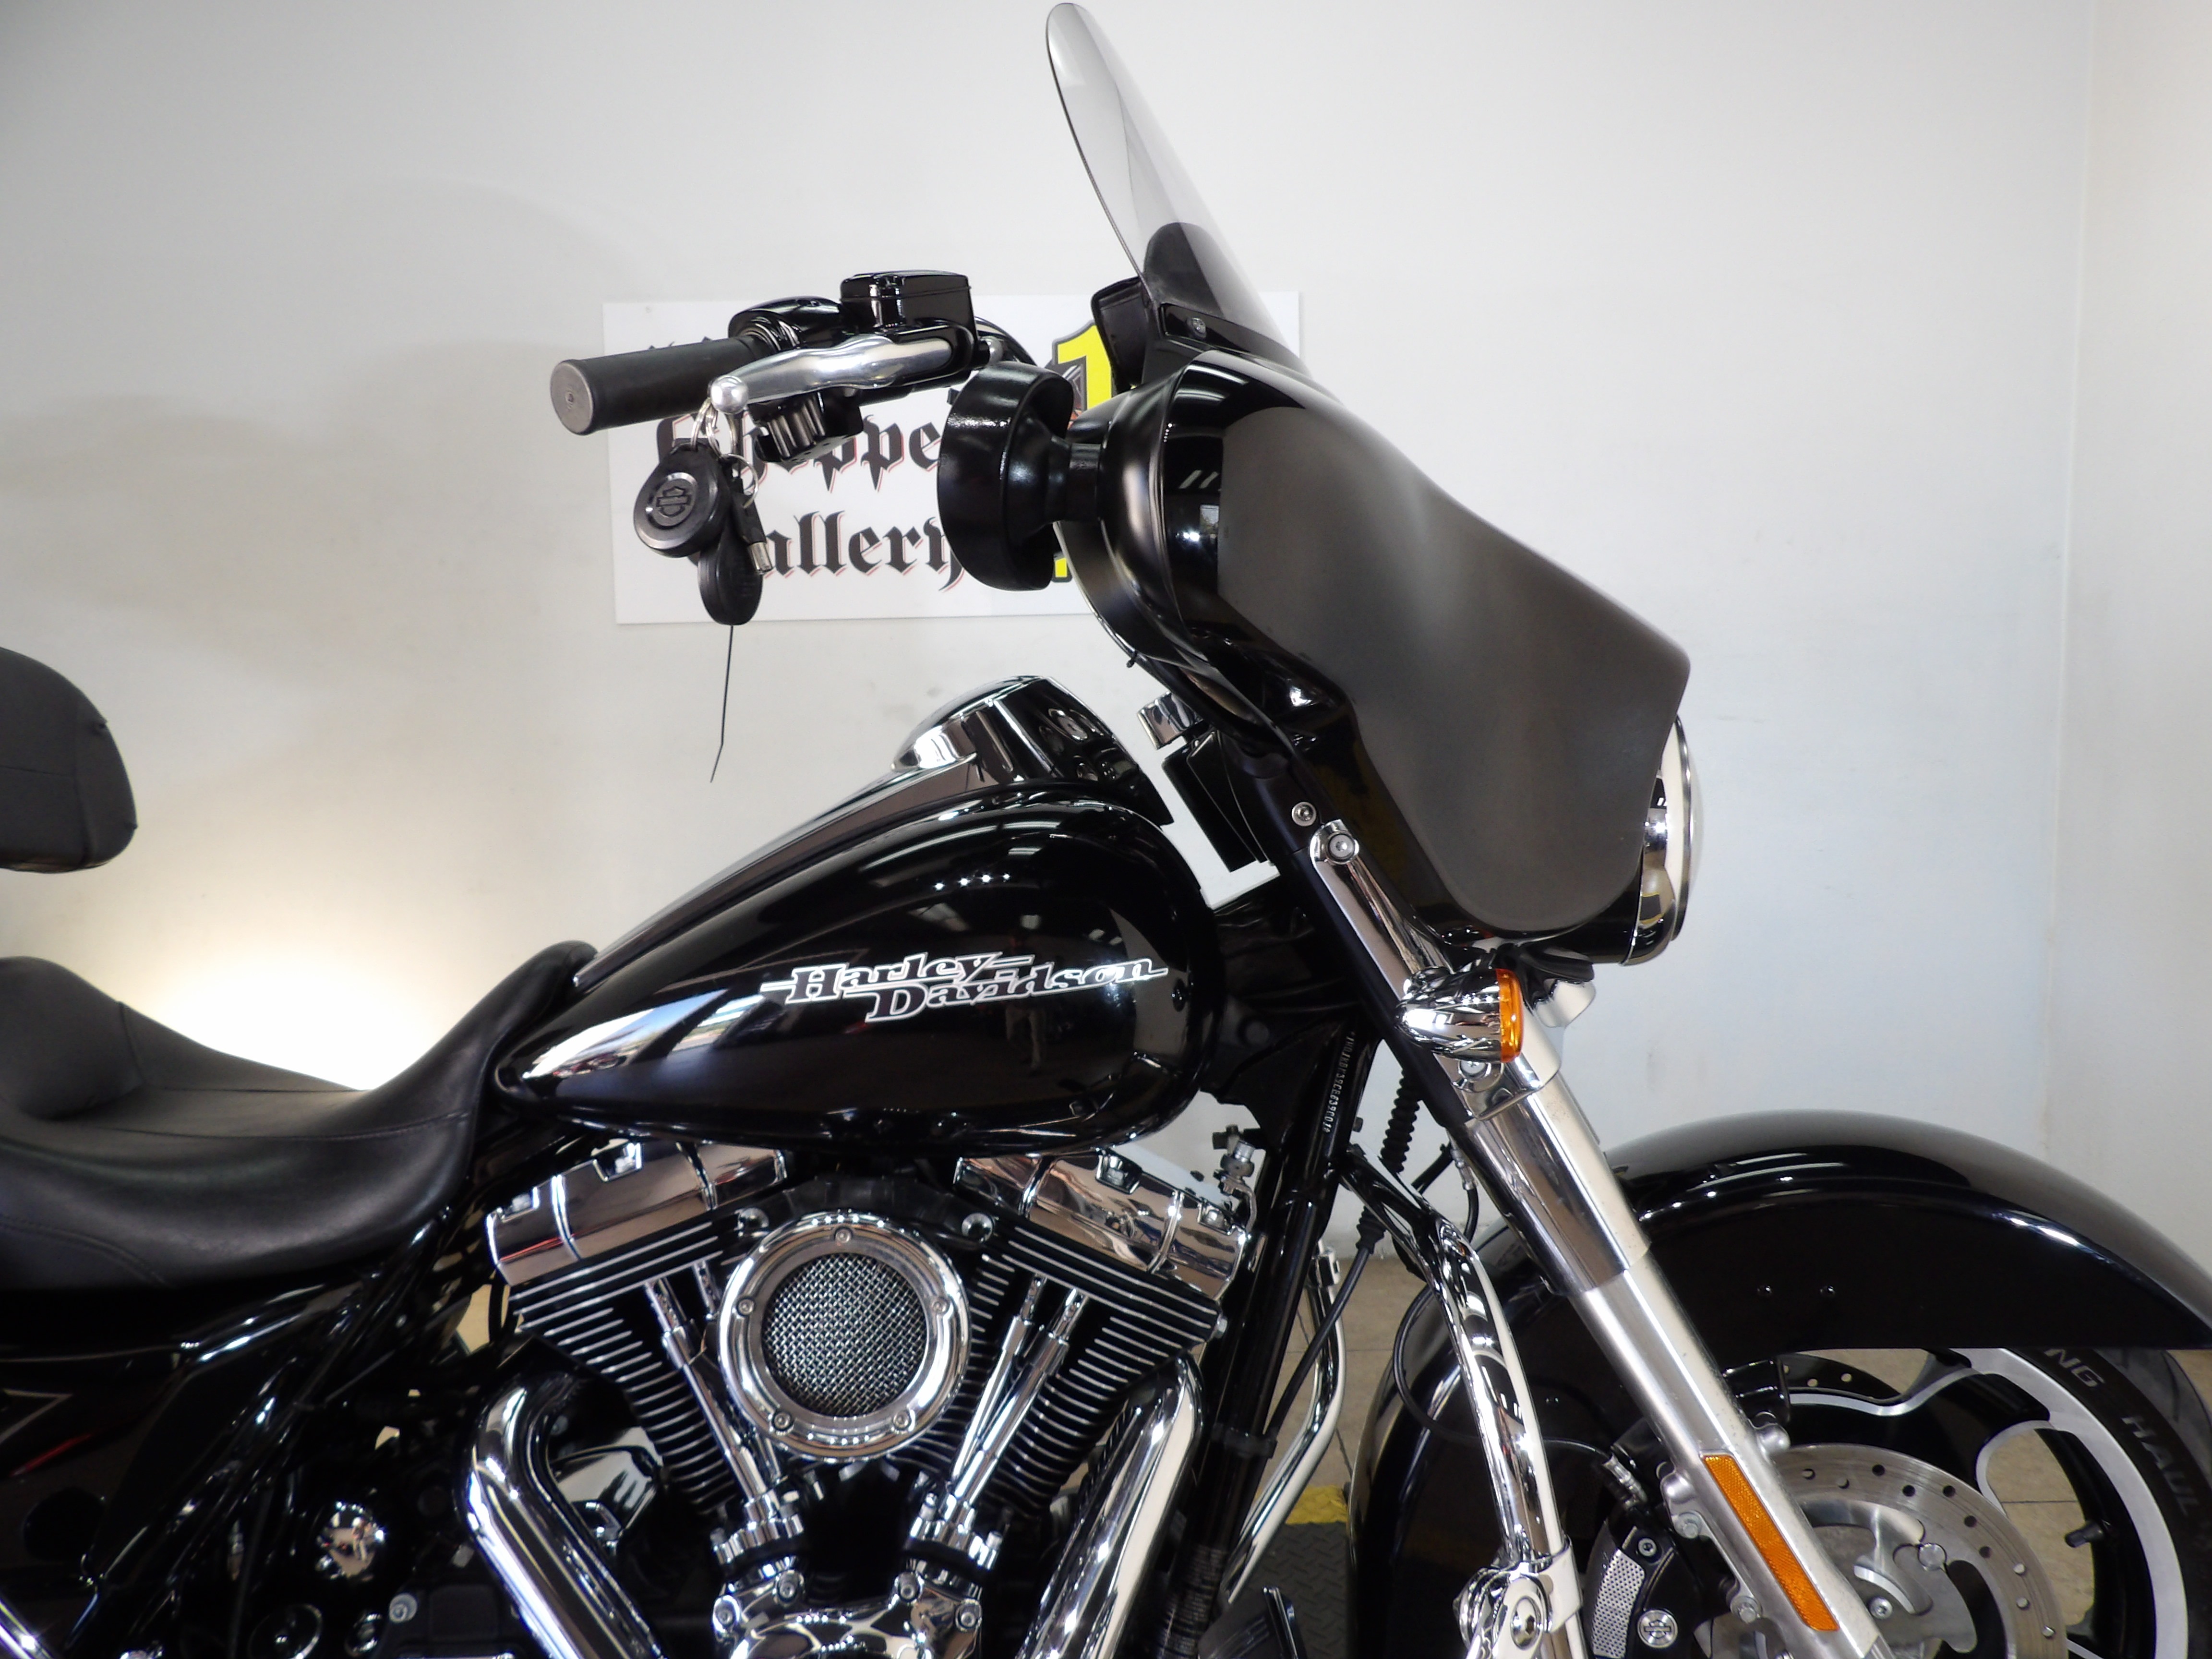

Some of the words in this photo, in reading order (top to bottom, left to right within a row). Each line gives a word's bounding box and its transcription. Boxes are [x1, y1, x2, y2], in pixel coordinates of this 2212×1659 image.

[687, 511, 964, 592] allery
[2044, 1348, 2105, 1387] NG
[2120, 1416, 2200, 1517] HAUL
